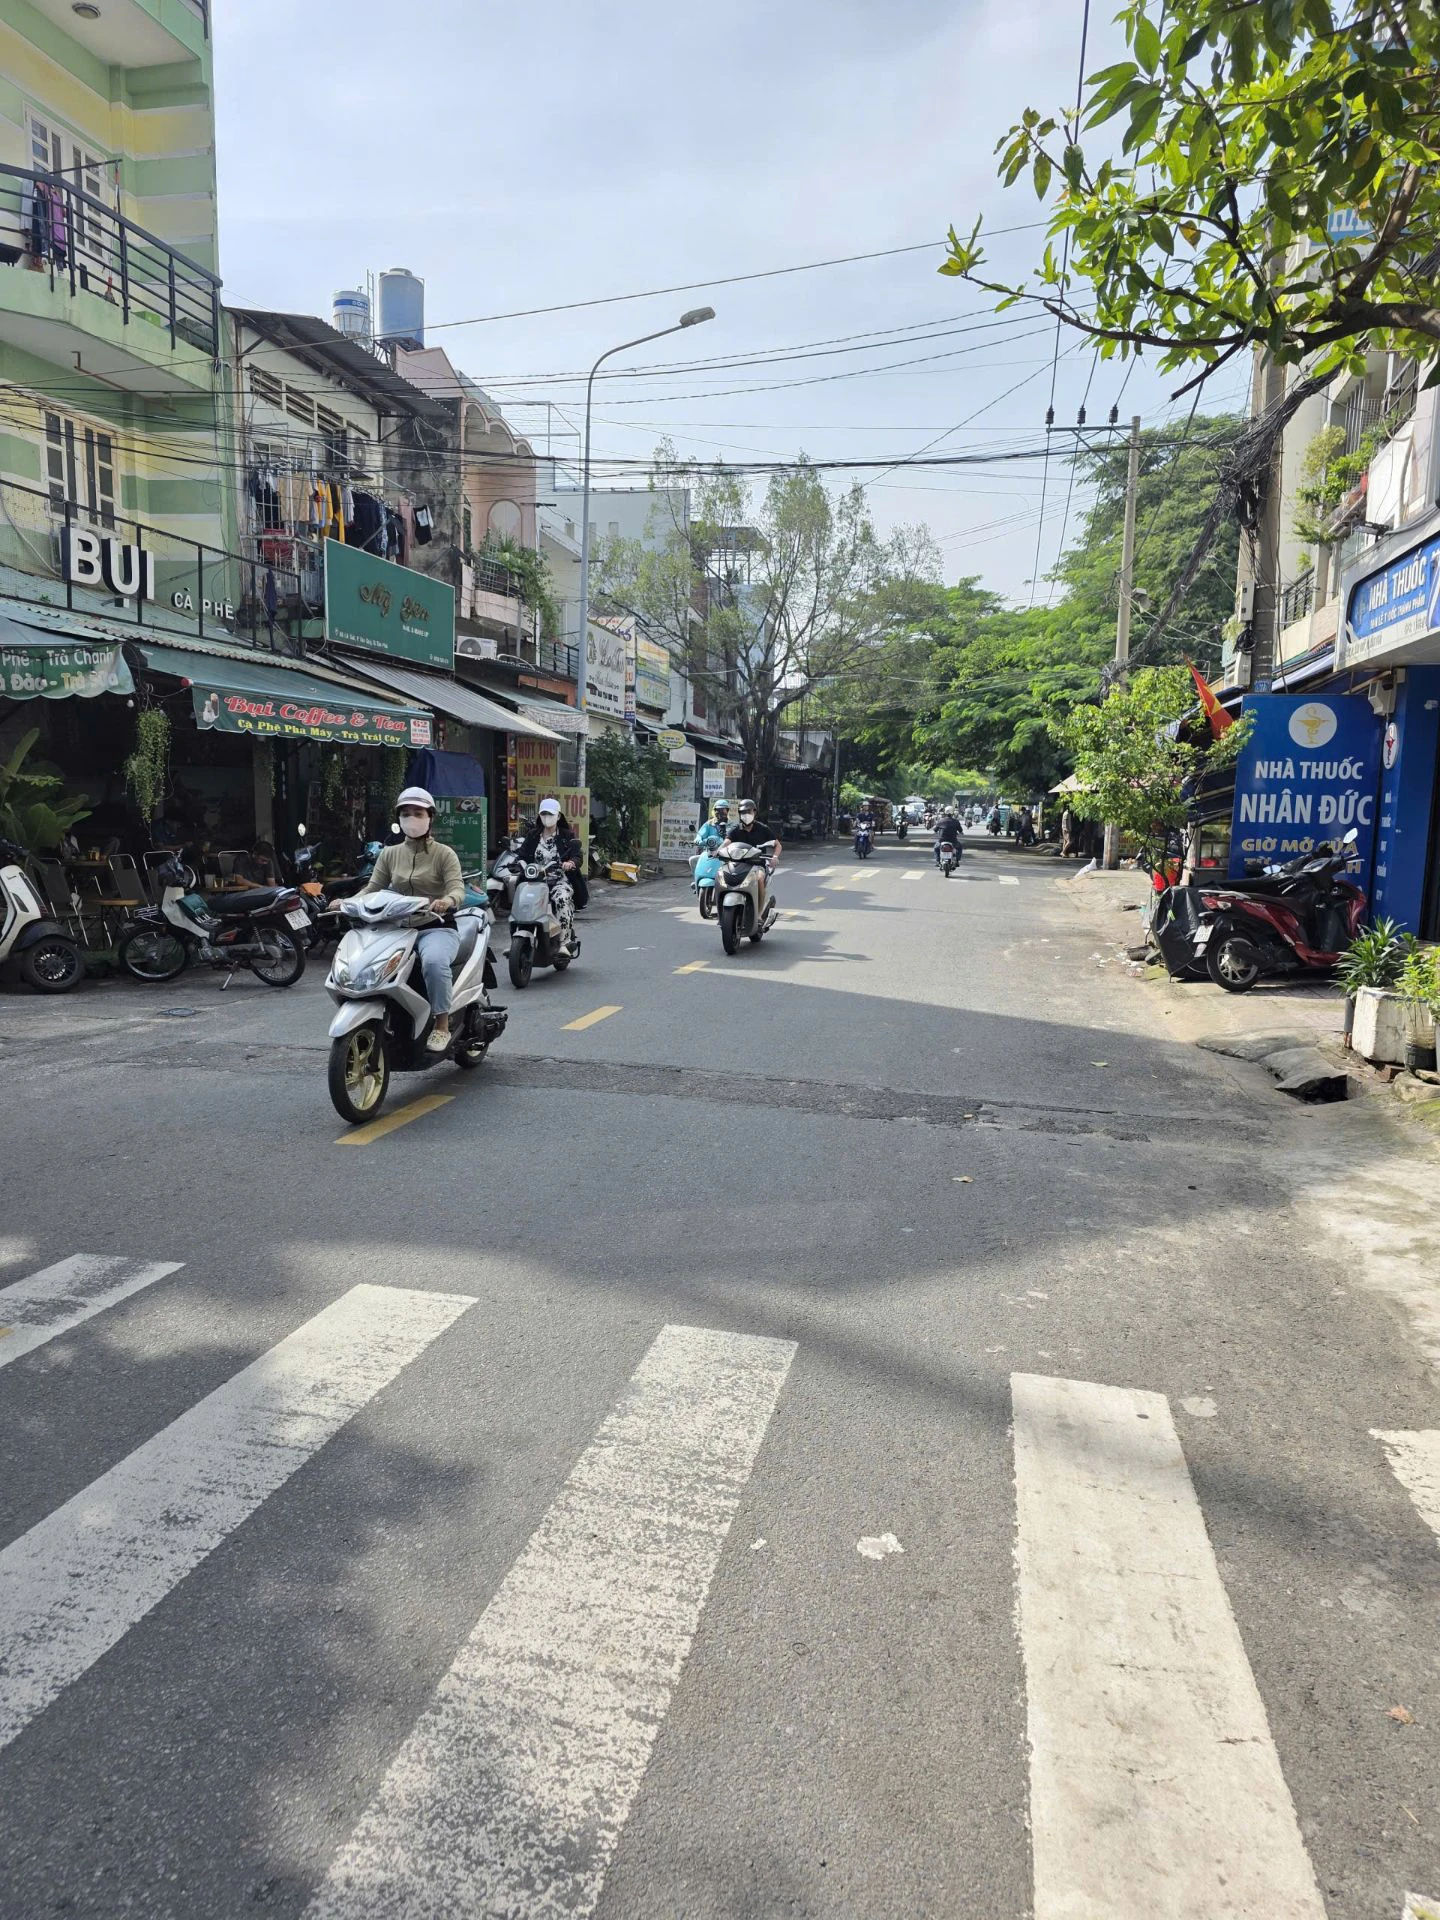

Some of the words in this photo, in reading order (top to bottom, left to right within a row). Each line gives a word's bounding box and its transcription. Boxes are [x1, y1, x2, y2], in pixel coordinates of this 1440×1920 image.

[68, 527, 154, 608] BỤI
[1368, 572, 1388, 612] NHÀ
[1392, 547, 1427, 599] THUỐC
[174, 587, 193, 610] CÀ
[203, 597, 235, 620] PHÊ
[2, 650, 30, 667] Phê
[47, 649, 69, 666] Trà
[74, 647, 114, 665] Chanh
[224, 696, 275, 717] Bụi
[280, 703, 347, 726] Coffee
[350, 713, 368, 727] &
[372, 715, 407, 731] Tea
[238, 719, 253, 729] Cà
[258, 722, 281, 732] Phê
[284, 725, 306, 735] Pha
[310, 727, 332, 739] Máy
[342, 731, 359, 740] Trà
[524, 764, 551, 776] NAM
[1255, 758, 1295, 779] NHÀ
[1300, 756, 1364, 779] THUỐC
[1240, 788, 1313, 824] NHÂN
[1318, 789, 1373, 825] ĐỨC
[1241, 837, 1277, 852] GIỜ
[1280, 836, 1315, 853] MỞ
